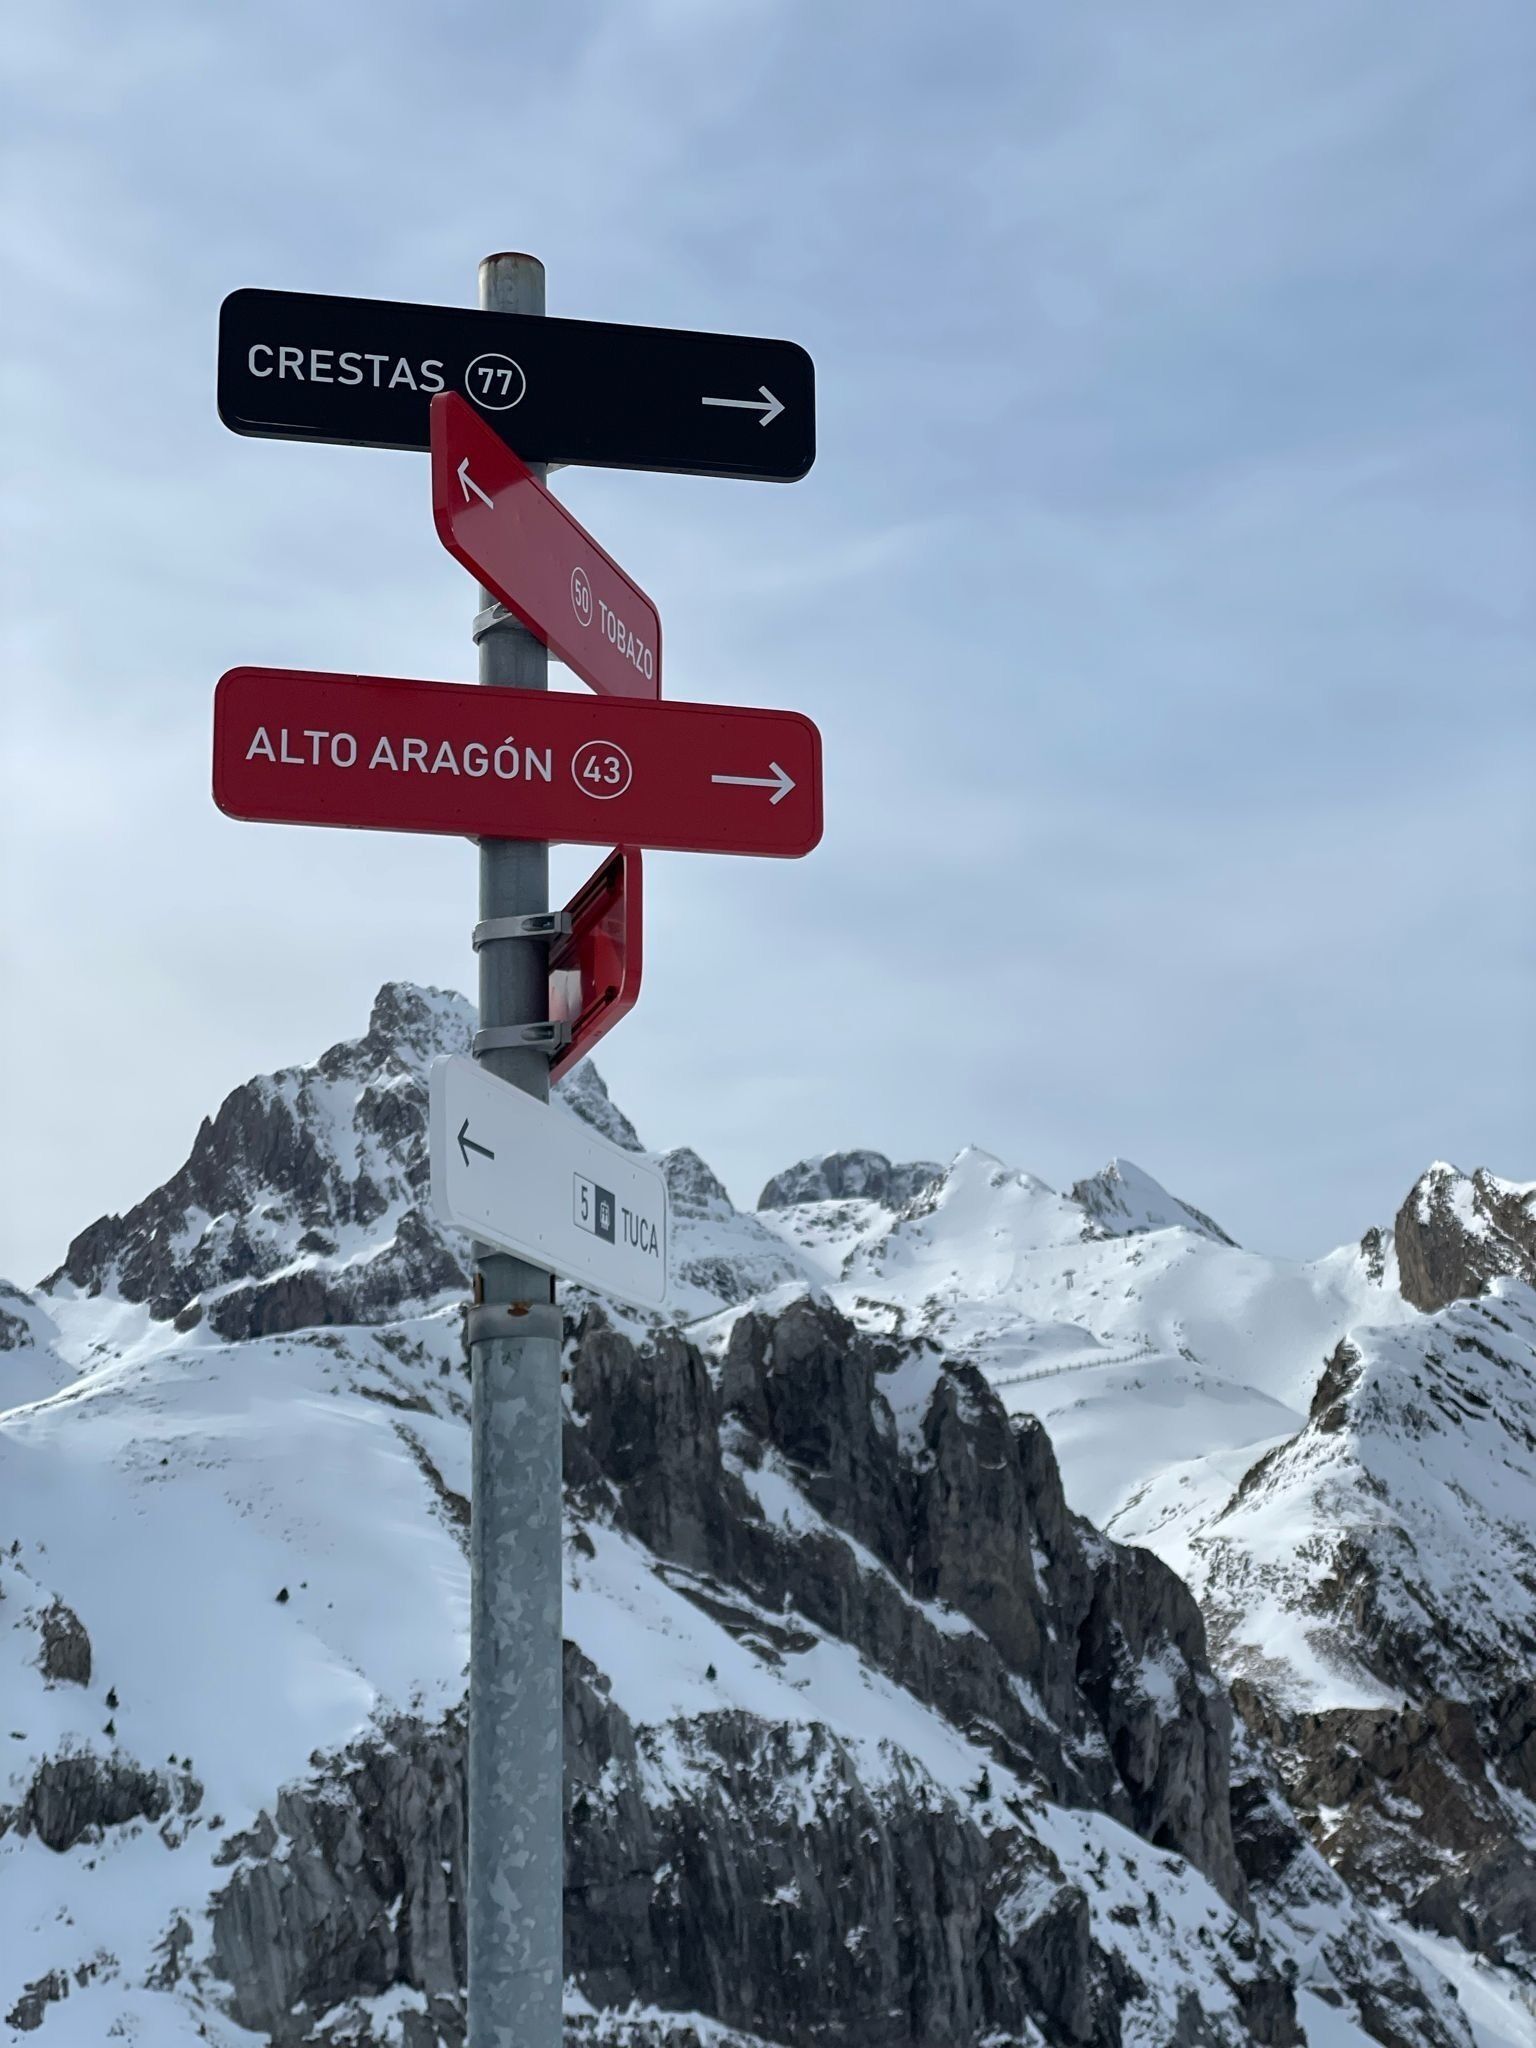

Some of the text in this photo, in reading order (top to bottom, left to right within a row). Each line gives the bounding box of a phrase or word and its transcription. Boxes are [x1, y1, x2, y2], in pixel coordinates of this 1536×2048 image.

[248, 344, 513, 396] CRESTAS 77
[575, 579, 653, 680] 50 TOBAZO
[246, 727, 621, 784] ALTO ARAGÓN 43
[581, 1185, 659, 1258] 5 TUCA
